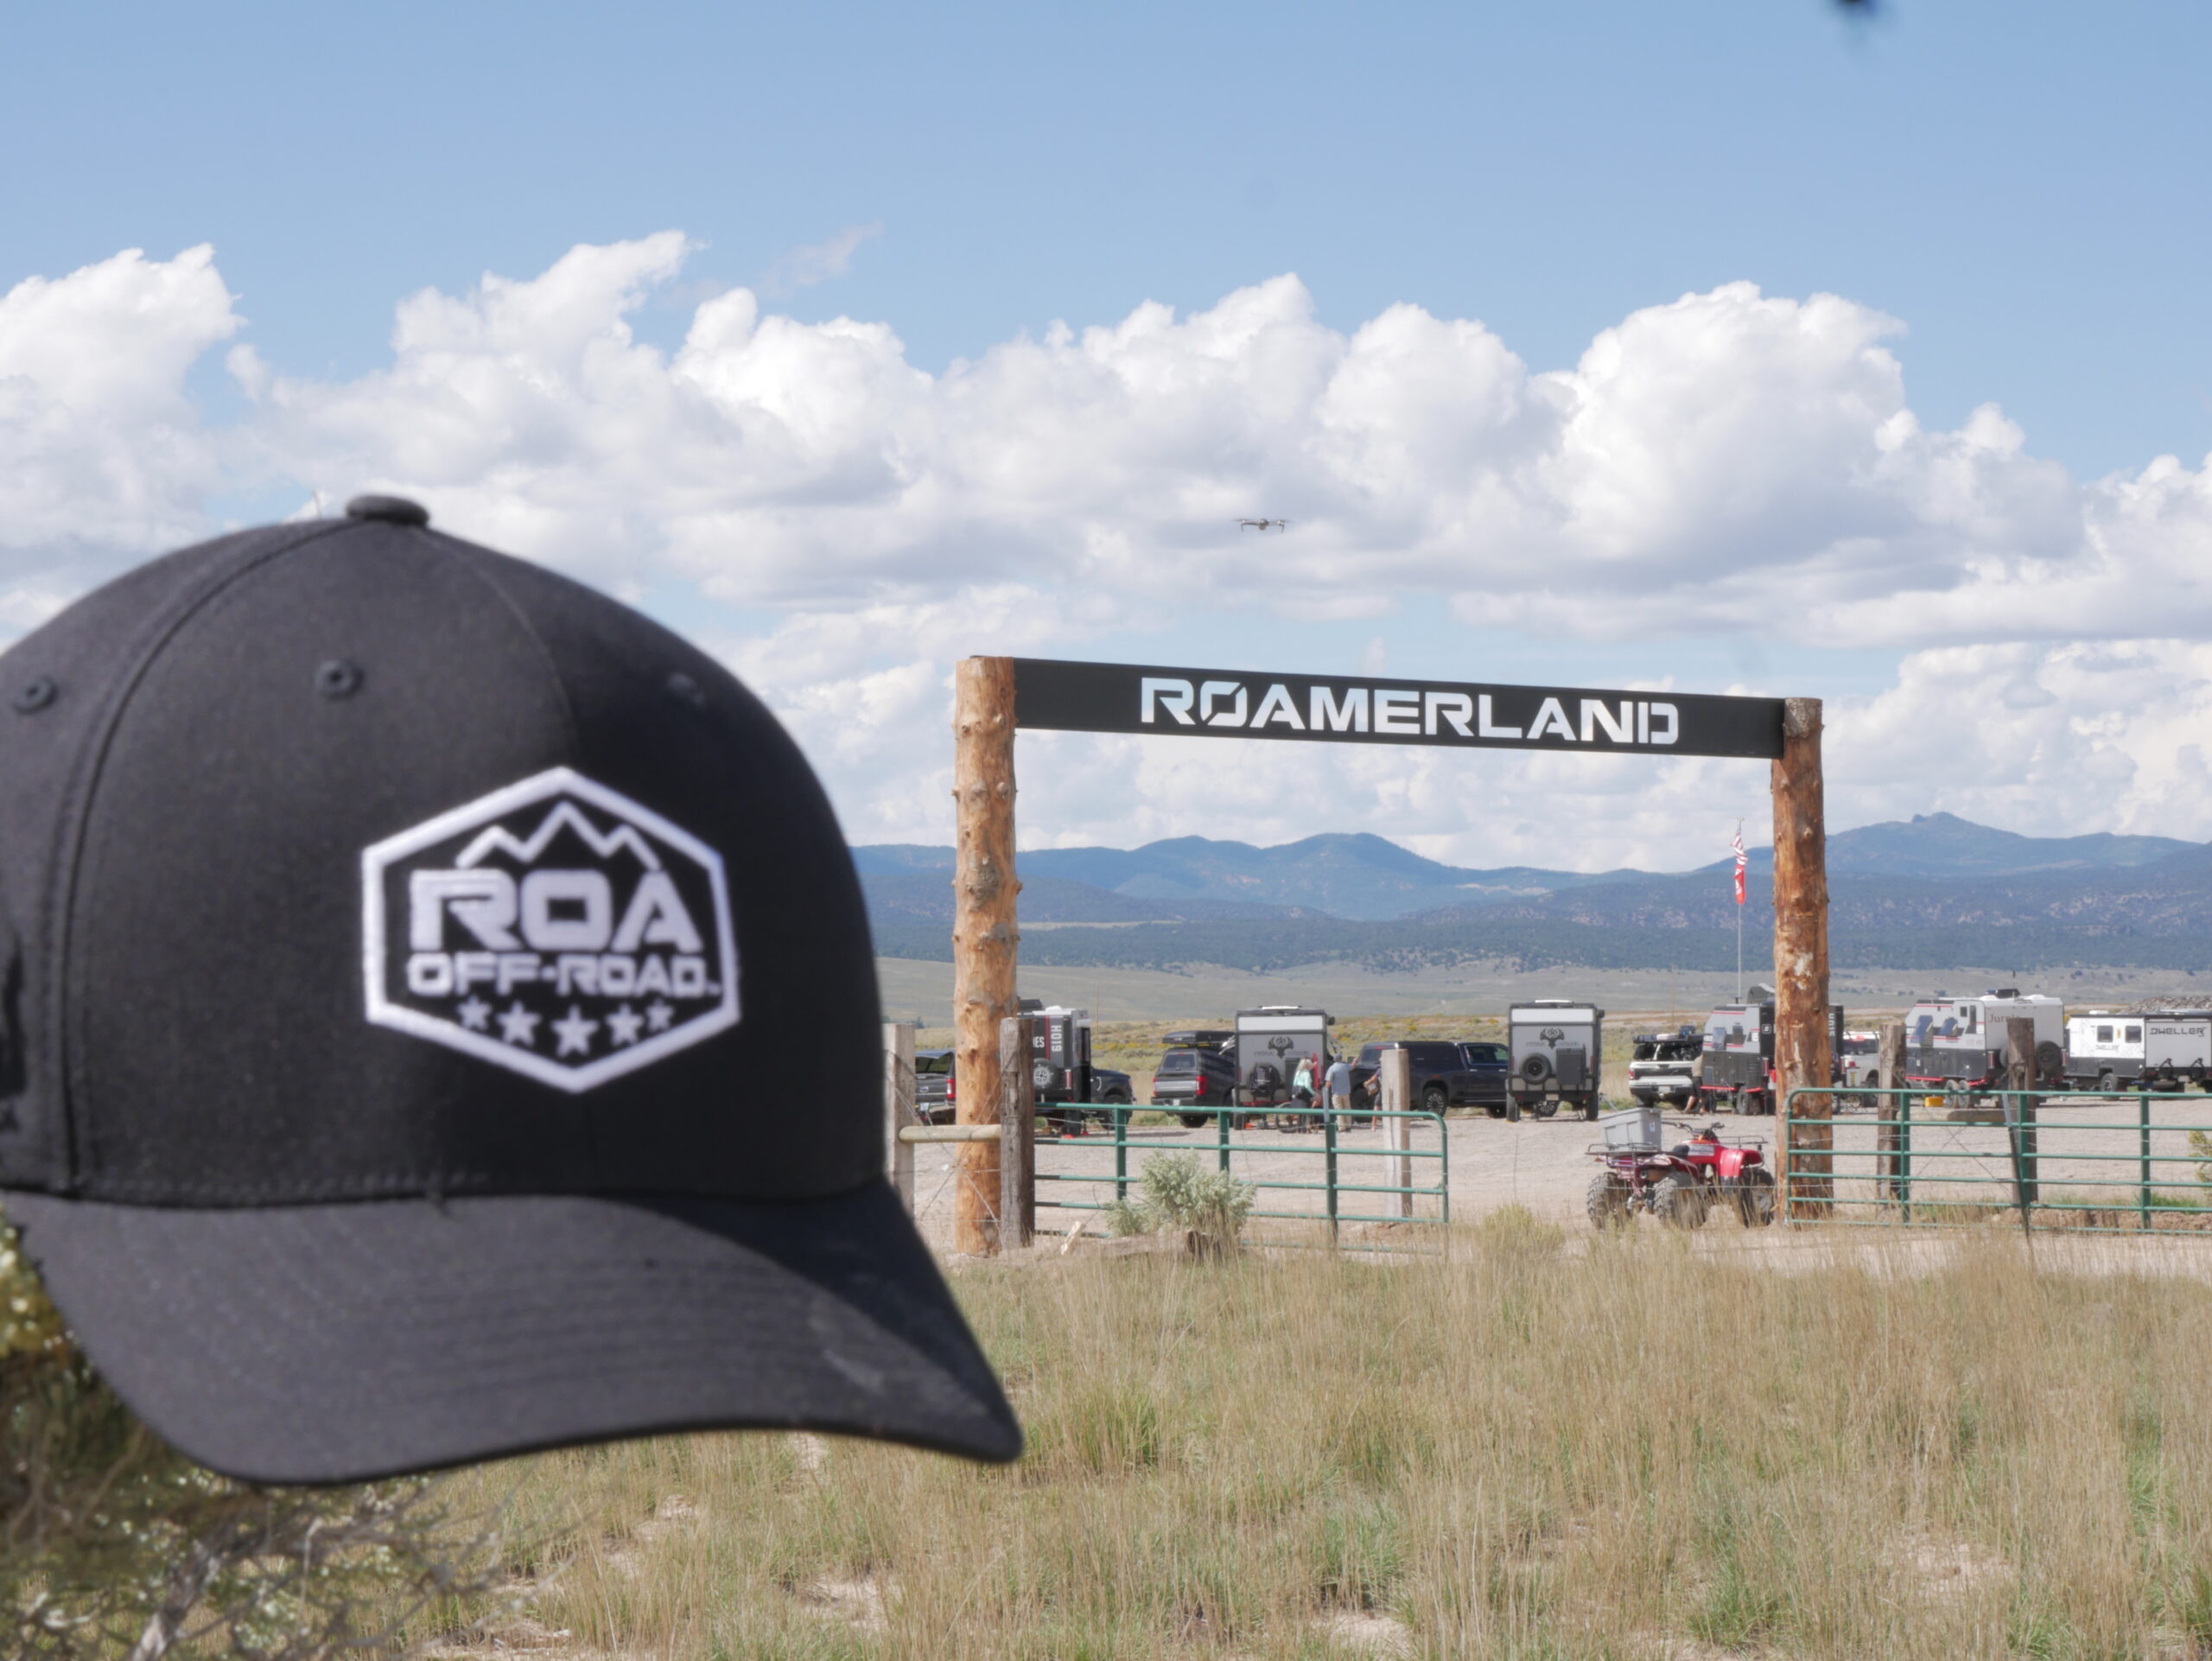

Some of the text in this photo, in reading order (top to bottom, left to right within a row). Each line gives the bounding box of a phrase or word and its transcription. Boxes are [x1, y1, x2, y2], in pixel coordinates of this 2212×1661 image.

[1141, 677, 1680, 746] ROAMERLAND
[410, 869, 703, 951] ROA
[407, 951, 707, 996] OFF-ROAD
[2150, 1027, 2204, 1037] DWELLER
